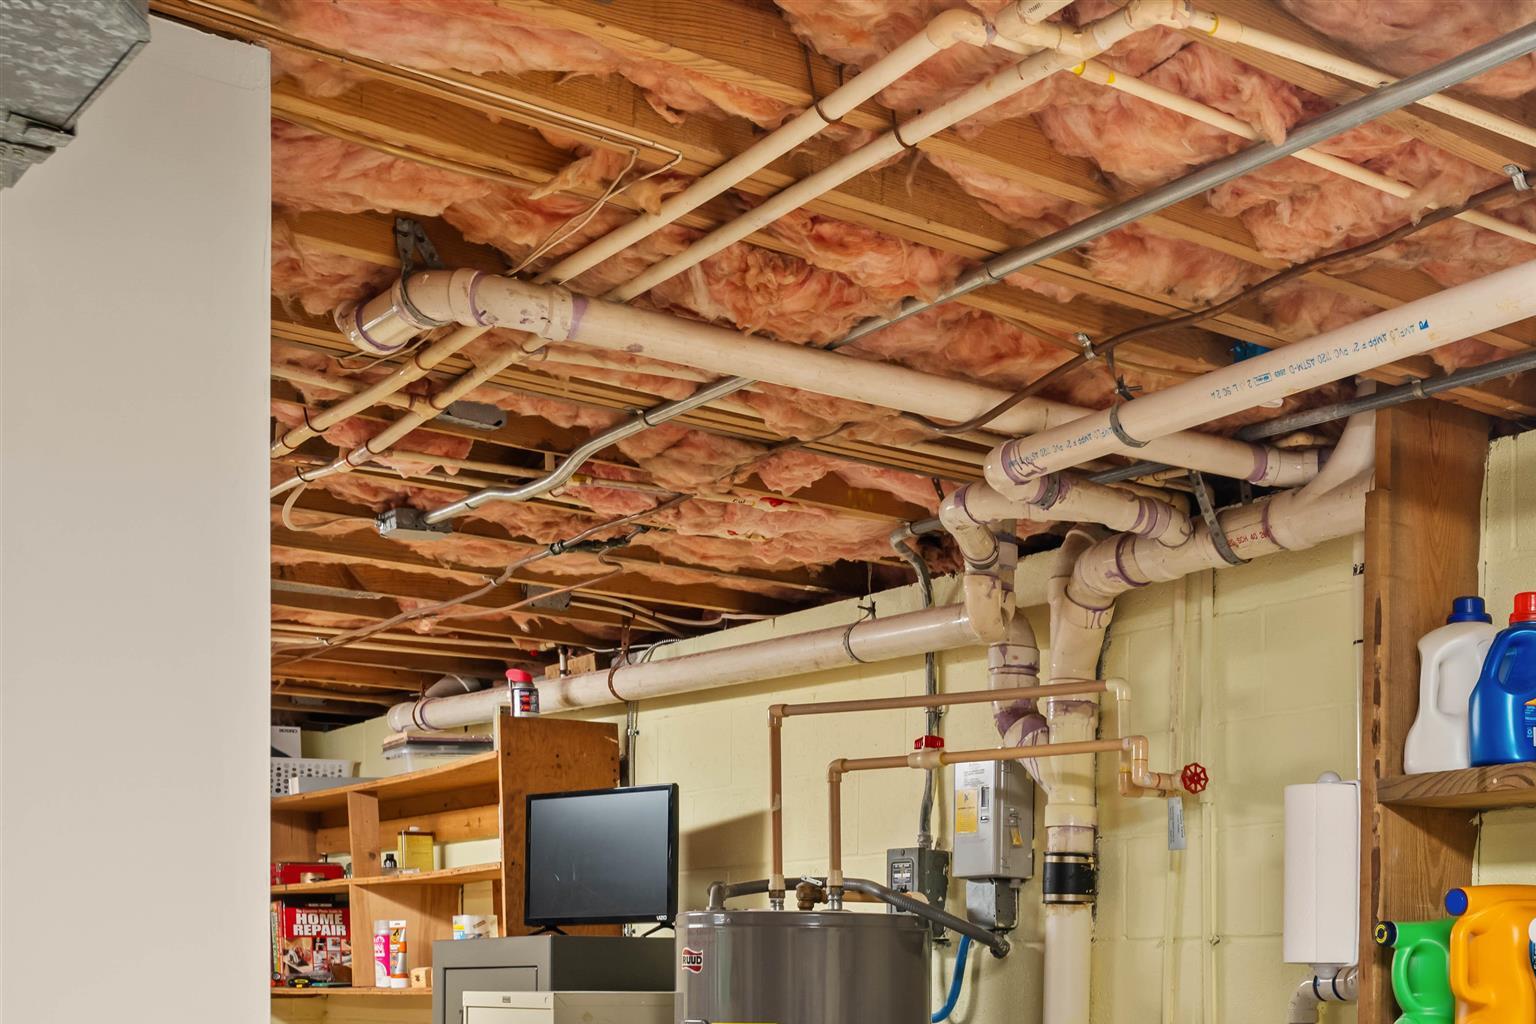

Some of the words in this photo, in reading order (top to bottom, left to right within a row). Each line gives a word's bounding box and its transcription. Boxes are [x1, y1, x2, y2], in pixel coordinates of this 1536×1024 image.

[296, 913, 343, 925] HOME
[293, 924, 347, 936] REPAIR
[682, 956, 702, 965] RUUD
